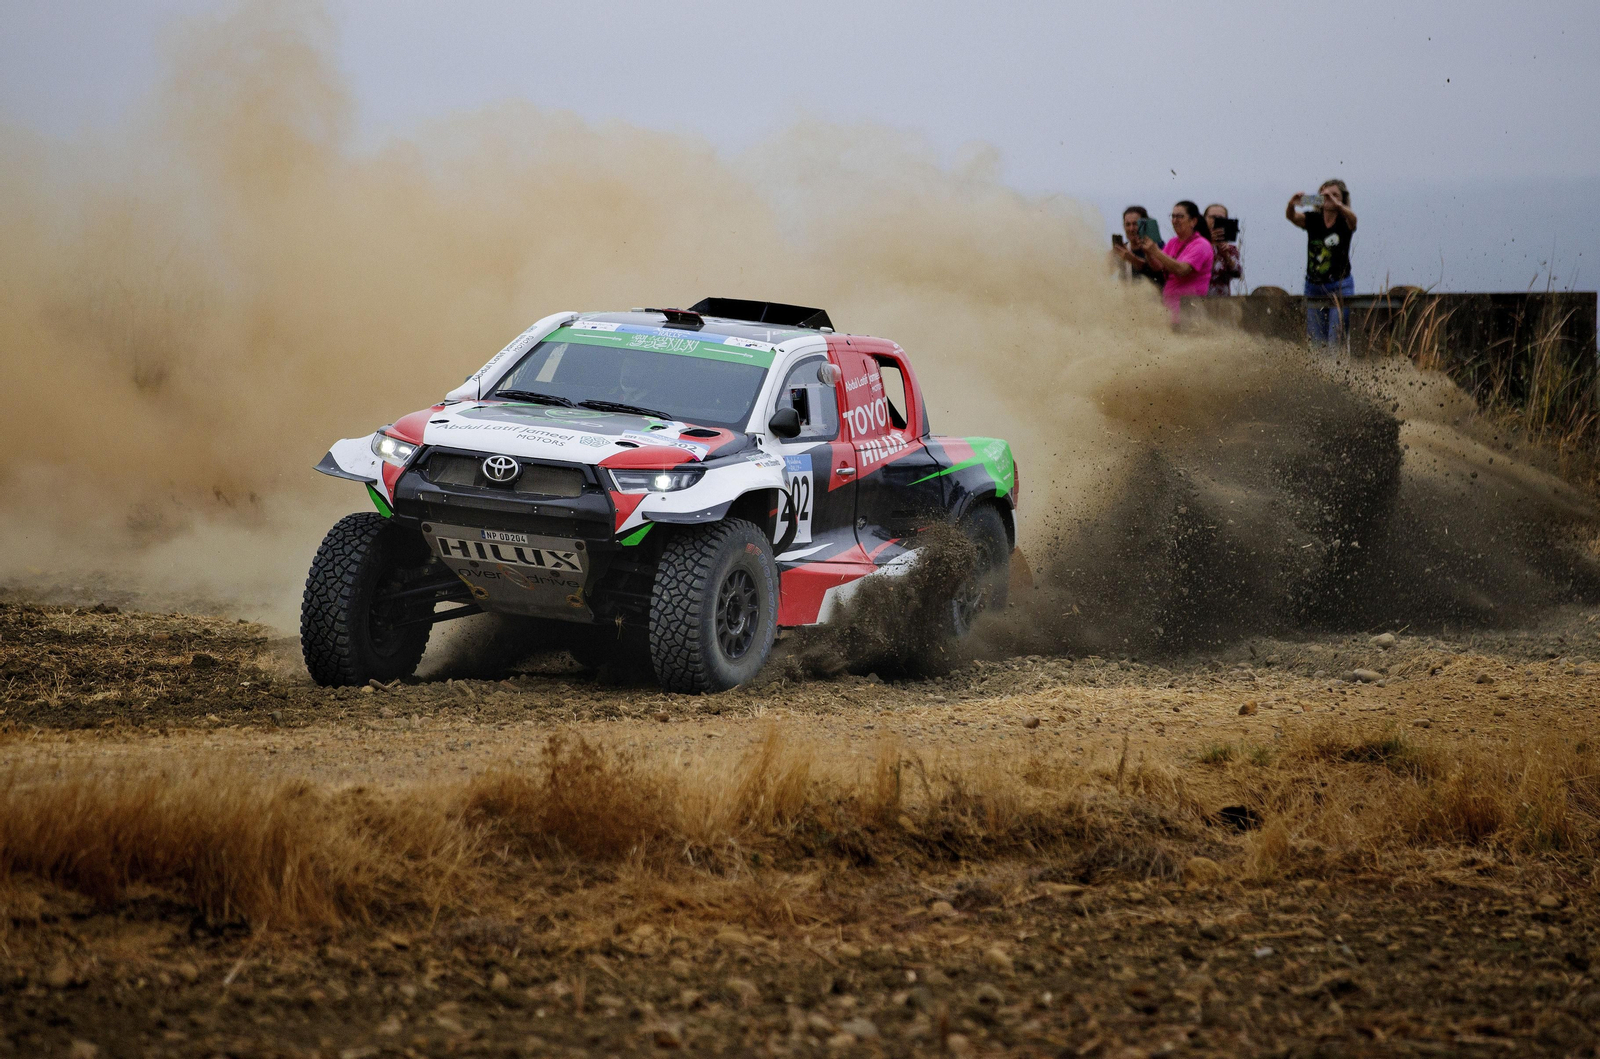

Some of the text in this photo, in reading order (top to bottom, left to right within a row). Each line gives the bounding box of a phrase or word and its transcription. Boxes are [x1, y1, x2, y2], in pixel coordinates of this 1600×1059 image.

[513, 335, 535, 353] MOTORS
[436, 423, 575, 441] Abdul Latif Jameel
[516, 433, 567, 447] MOTORS
[859, 433, 909, 467] HILUX
[486, 531, 497, 539] NP
[437, 538, 580, 570] HILUX
[458, 567, 580, 588] over drive
